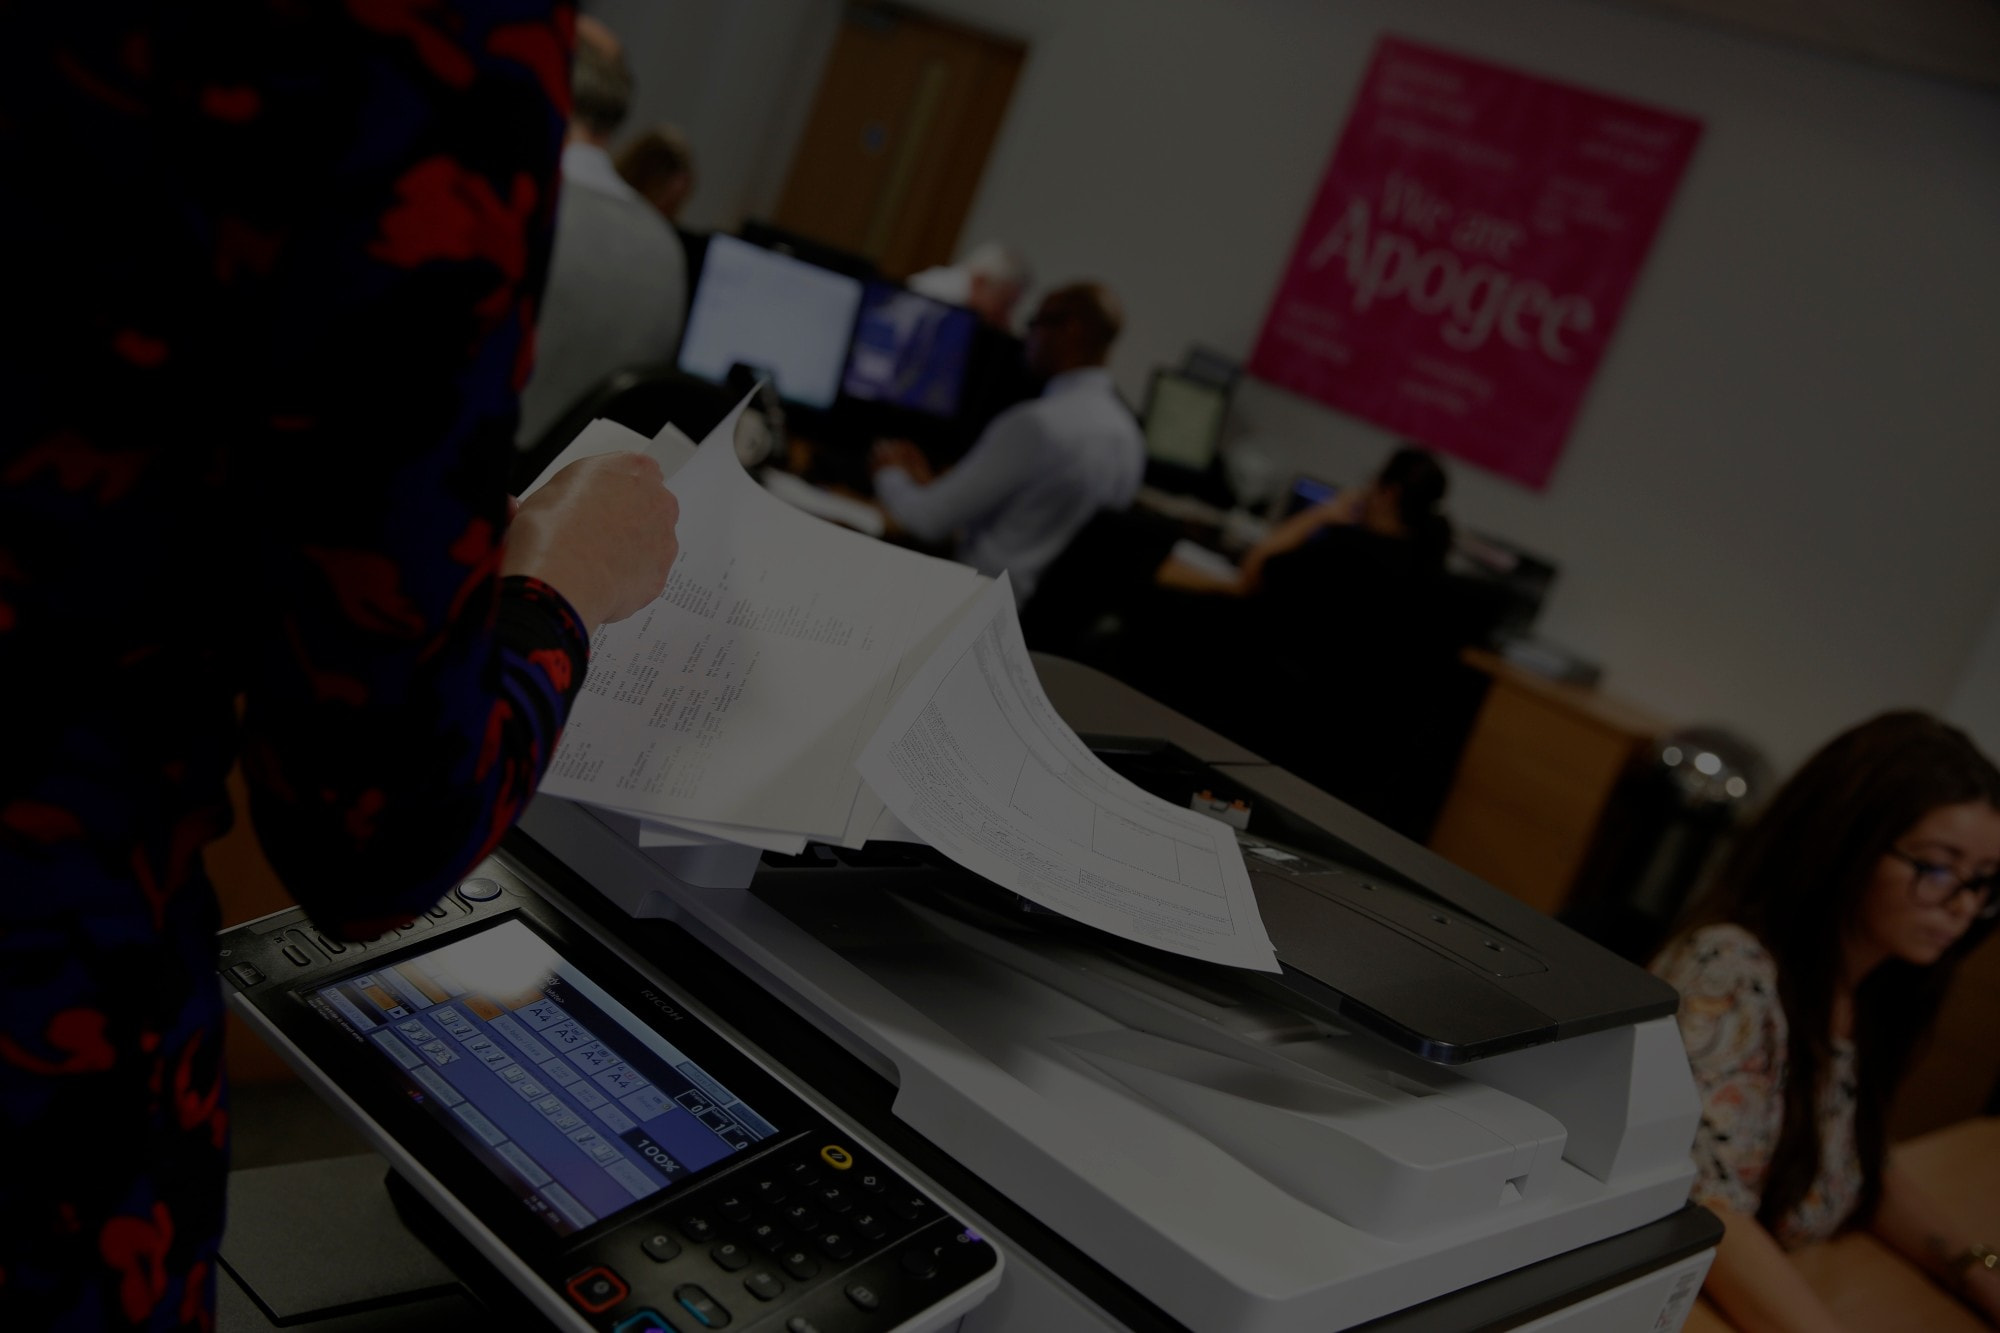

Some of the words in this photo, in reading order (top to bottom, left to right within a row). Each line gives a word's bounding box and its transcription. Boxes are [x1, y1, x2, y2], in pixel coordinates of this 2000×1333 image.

[1382, 168, 1453, 240] We
[1453, 211, 1527, 262] are
[1307, 197, 1595, 364] Apogee
[641, 990, 684, 1022] RICOH
[529, 1006, 551, 1022] A4
[555, 1029, 578, 1043] A3
[580, 1052, 603, 1066] A4
[608, 1073, 630, 1088] A4
[693, 1105, 703, 1113] 0
[714, 1123, 725, 1131] 1
[736, 1141, 748, 1150] 0
[637, 1138, 680, 1173] 100%
[825, 1189, 840, 1198] 2
[724, 1198, 739, 1206] 7
[791, 1207, 806, 1216] 5
[859, 1215, 873, 1225] 3
[757, 1225, 772, 1236] 8
[652, 1234, 667, 1245] C
[826, 1235, 840, 1245] 6
[721, 1244, 736, 1255] 0
[790, 1253, 805, 1263] 9
